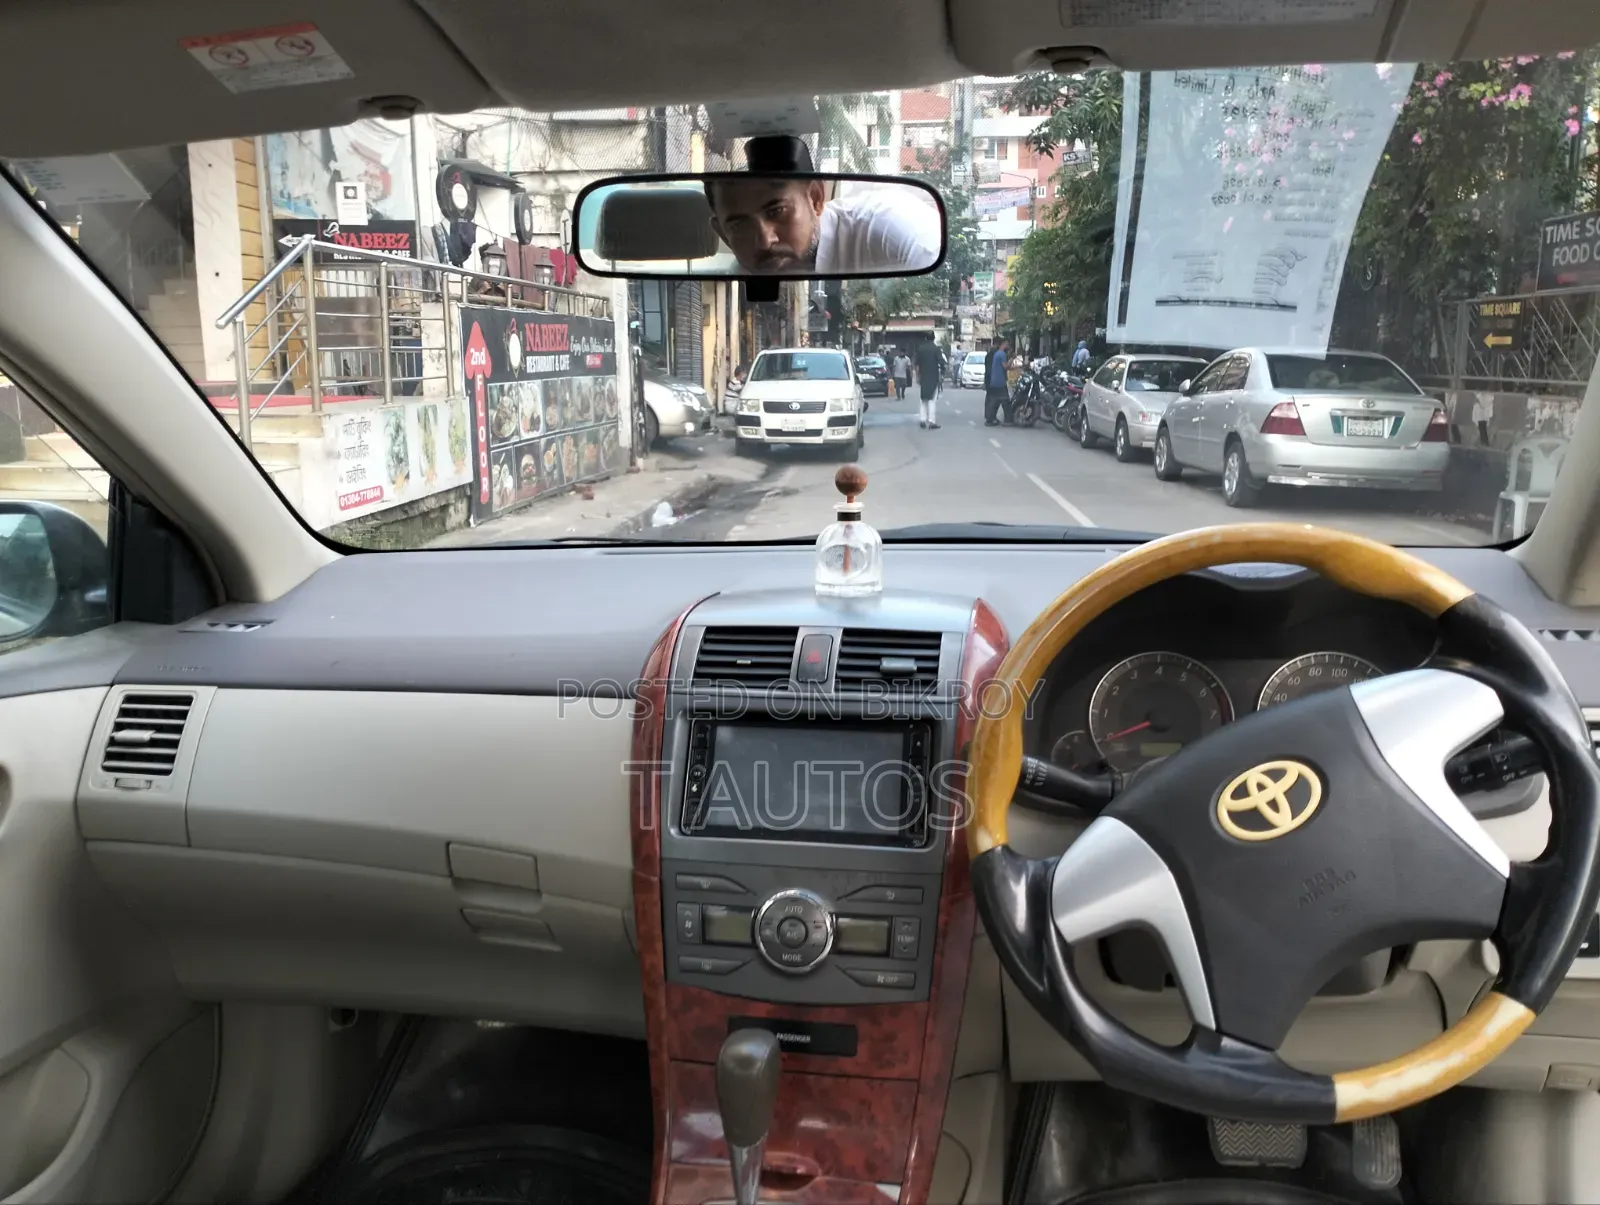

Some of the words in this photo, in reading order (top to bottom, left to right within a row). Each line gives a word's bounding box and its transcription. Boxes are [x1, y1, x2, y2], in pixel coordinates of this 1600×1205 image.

[1063, 152, 1076, 161] KS
[333, 232, 410, 249] NABEEZ
[1545, 221, 1581, 245] TIME
[1552, 242, 1590, 267] FOOD
[1480, 304, 1495, 317] TIME
[1495, 302, 1521, 317] SQUARE
[525, 323, 569, 352] NABEEZ
[470, 347, 486, 366] 2nd
[526, 355, 555, 373] RESTAURANT
[560, 354, 570, 371] CAFE
[477, 375, 489, 492] FLOOR
[1112, 686, 1120, 695] 2
[1130, 670, 1138, 680] 3
[1155, 666, 1163, 675] 4
[1179, 672, 1187, 682] 5
[1199, 688, 1207, 698] 6
[1274, 693, 1288, 703] 40
[1287, 676, 1301, 685] 60
[1308, 667, 1322, 677] 80
[1331, 668, 1348, 677] 100
[784, 905, 803, 913] AUTO
[782, 954, 802, 962] MODE
[775, 1032, 811, 1043] PASSENGER
